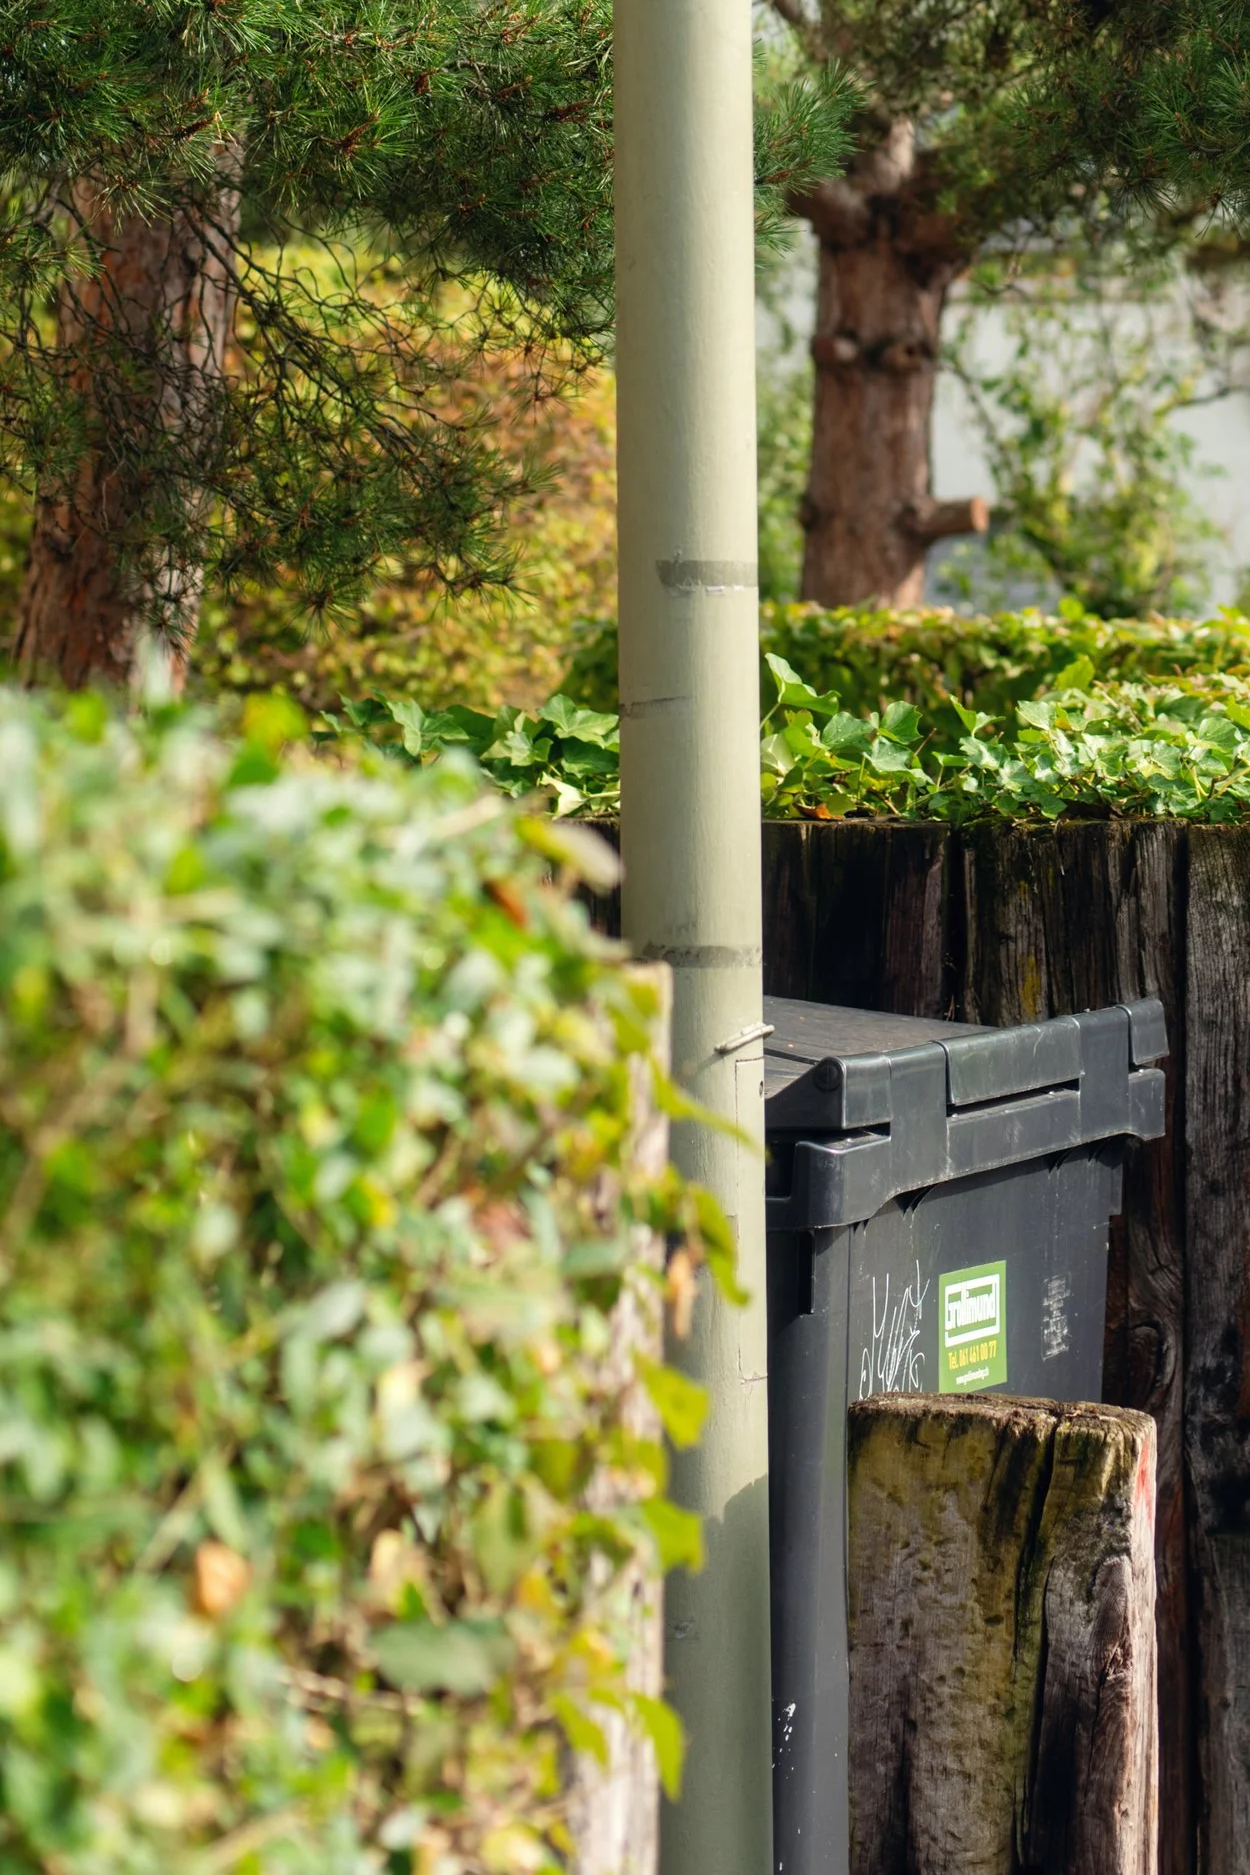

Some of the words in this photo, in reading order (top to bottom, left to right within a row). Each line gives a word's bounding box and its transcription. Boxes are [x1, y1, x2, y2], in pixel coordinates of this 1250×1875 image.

[948, 1351, 959, 1371] Tel.
[959, 1347, 968, 1367] 061
[988, 1340, 997, 1358] 77
